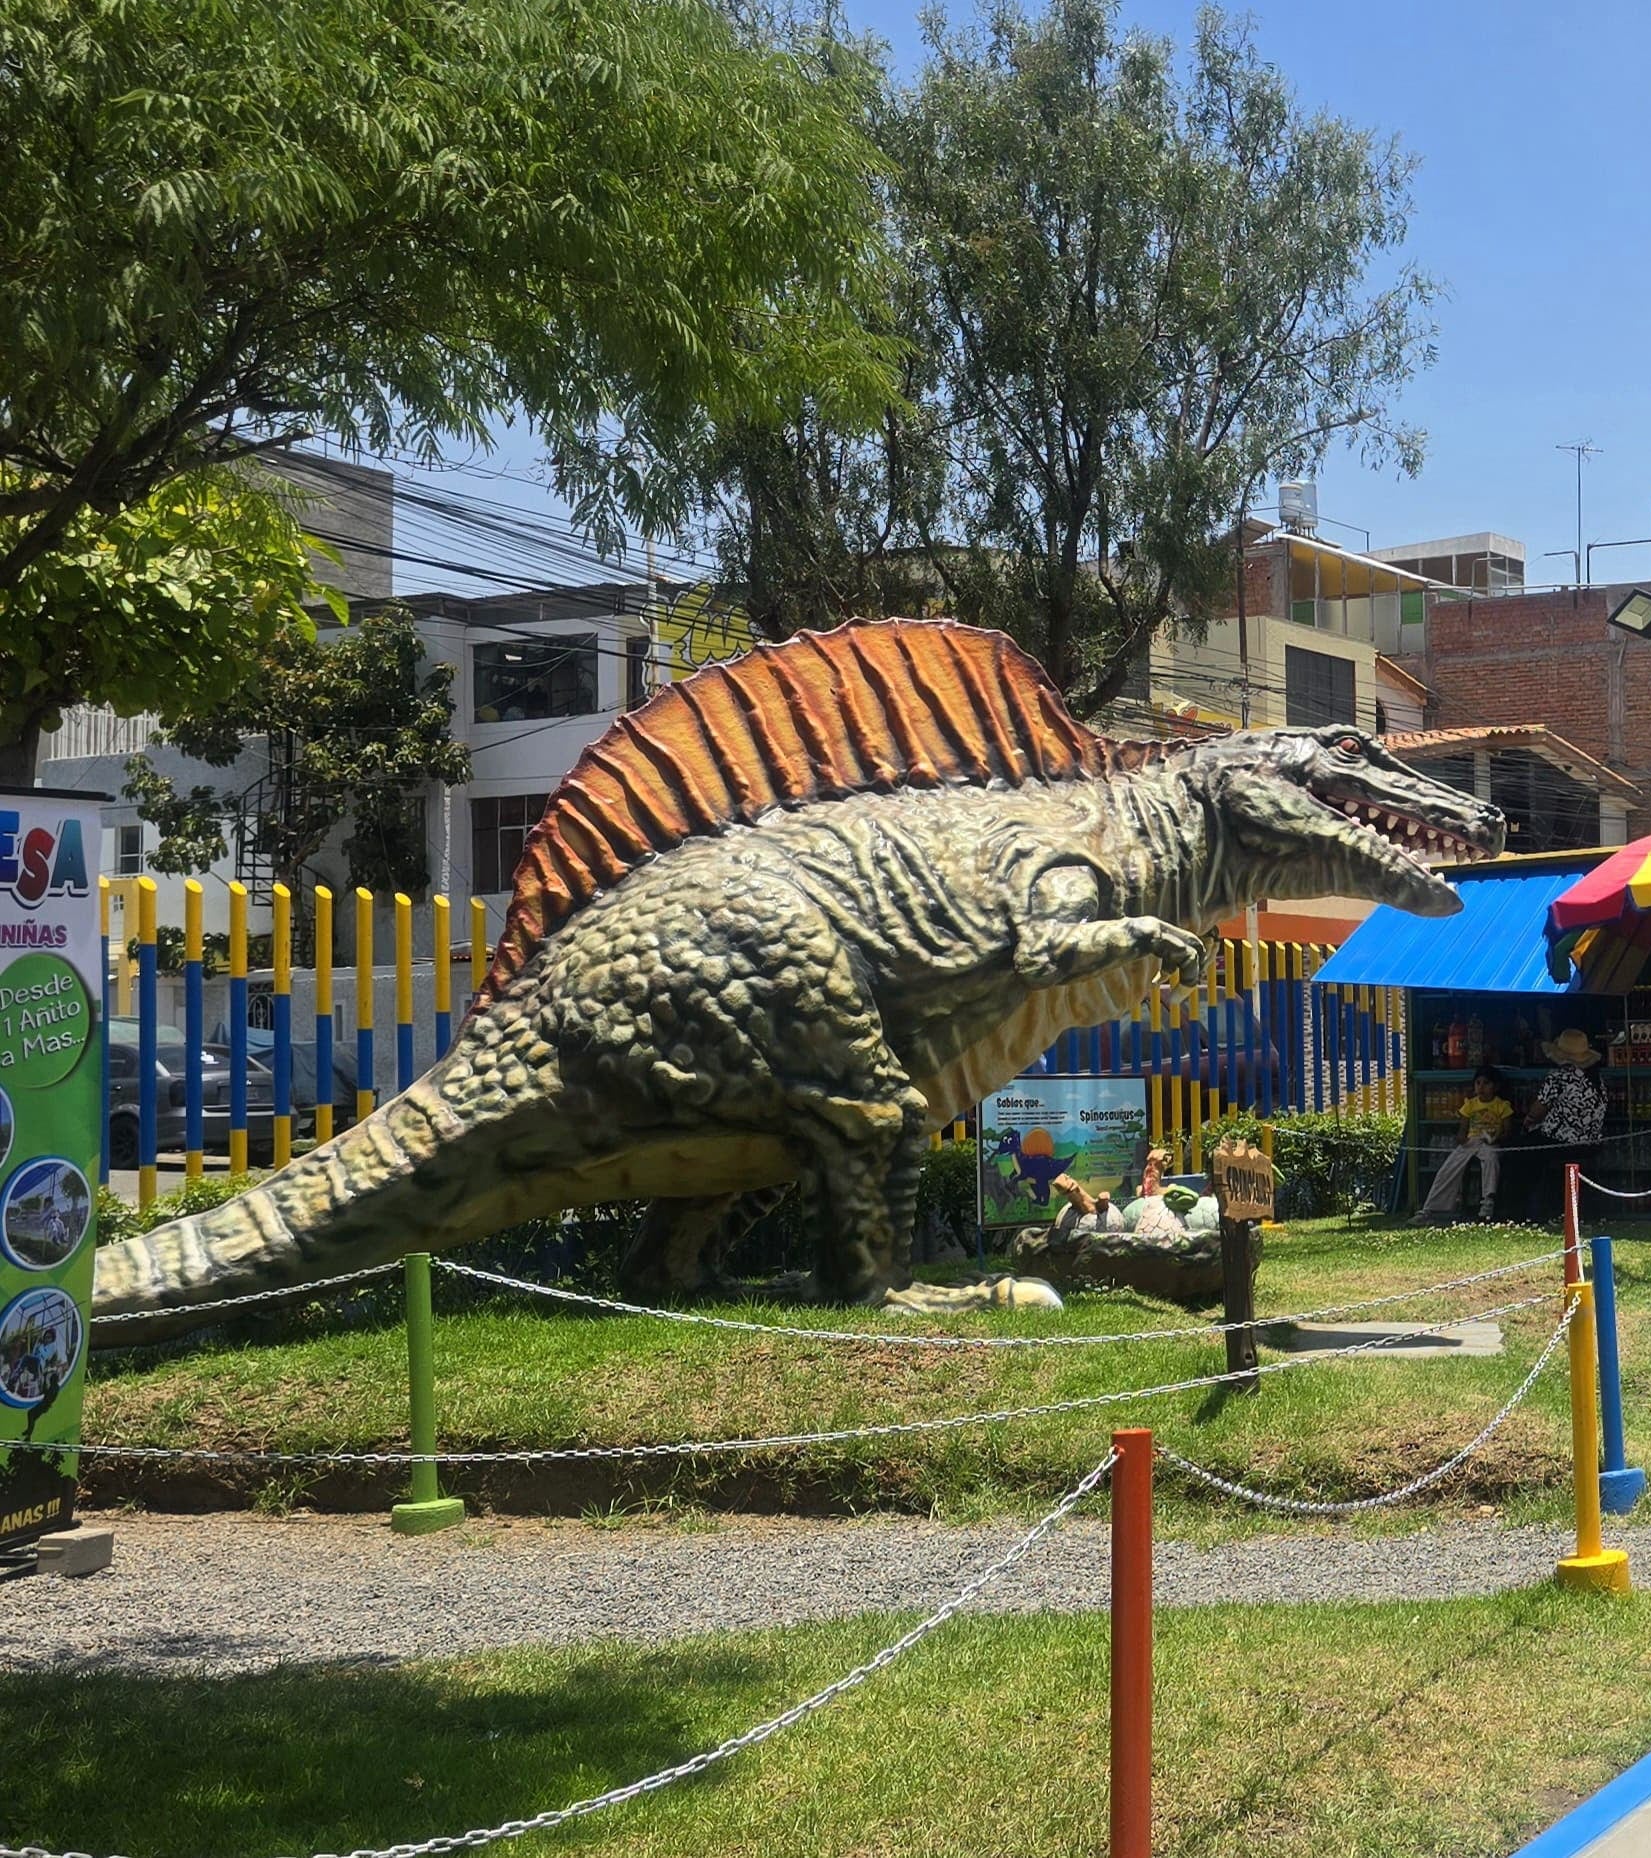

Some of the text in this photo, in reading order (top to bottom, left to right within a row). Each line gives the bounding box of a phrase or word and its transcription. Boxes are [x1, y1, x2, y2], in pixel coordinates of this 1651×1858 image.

[0, 973, 74, 1011] Desde
[4, 1000, 81, 1037] 1 Añito
[1, 1032, 86, 1067] a Mas...
[1079, 1109, 1135, 1123] Spinosaurus
